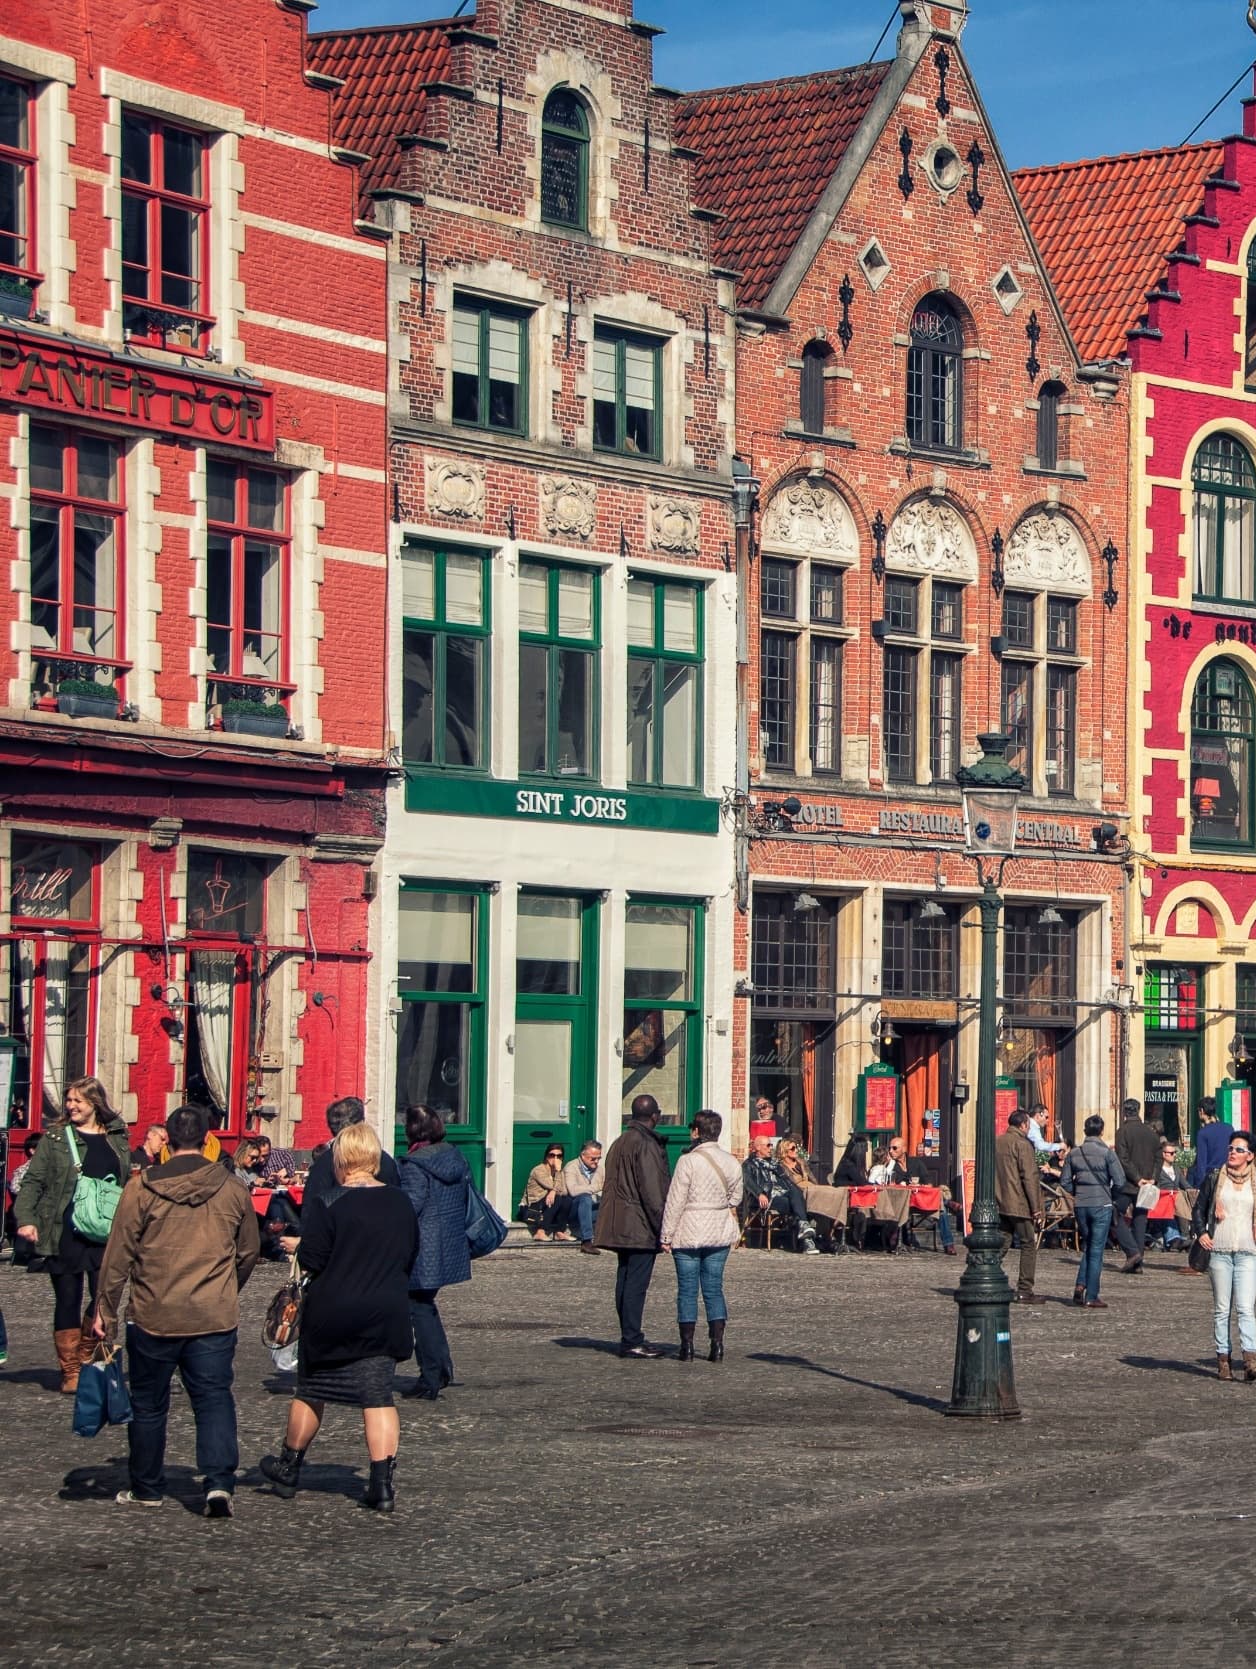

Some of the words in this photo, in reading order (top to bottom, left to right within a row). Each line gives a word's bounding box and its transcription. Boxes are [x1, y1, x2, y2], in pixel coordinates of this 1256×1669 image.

[171, 386, 263, 442] D'OR
[516, 790, 564, 815] SINT
[570, 795, 627, 820] JORIS
[879, 811, 965, 836] RESTAURA
[1016, 820, 1081, 844] CENTRAL
[1144, 1091, 1161, 1103] PASTA
